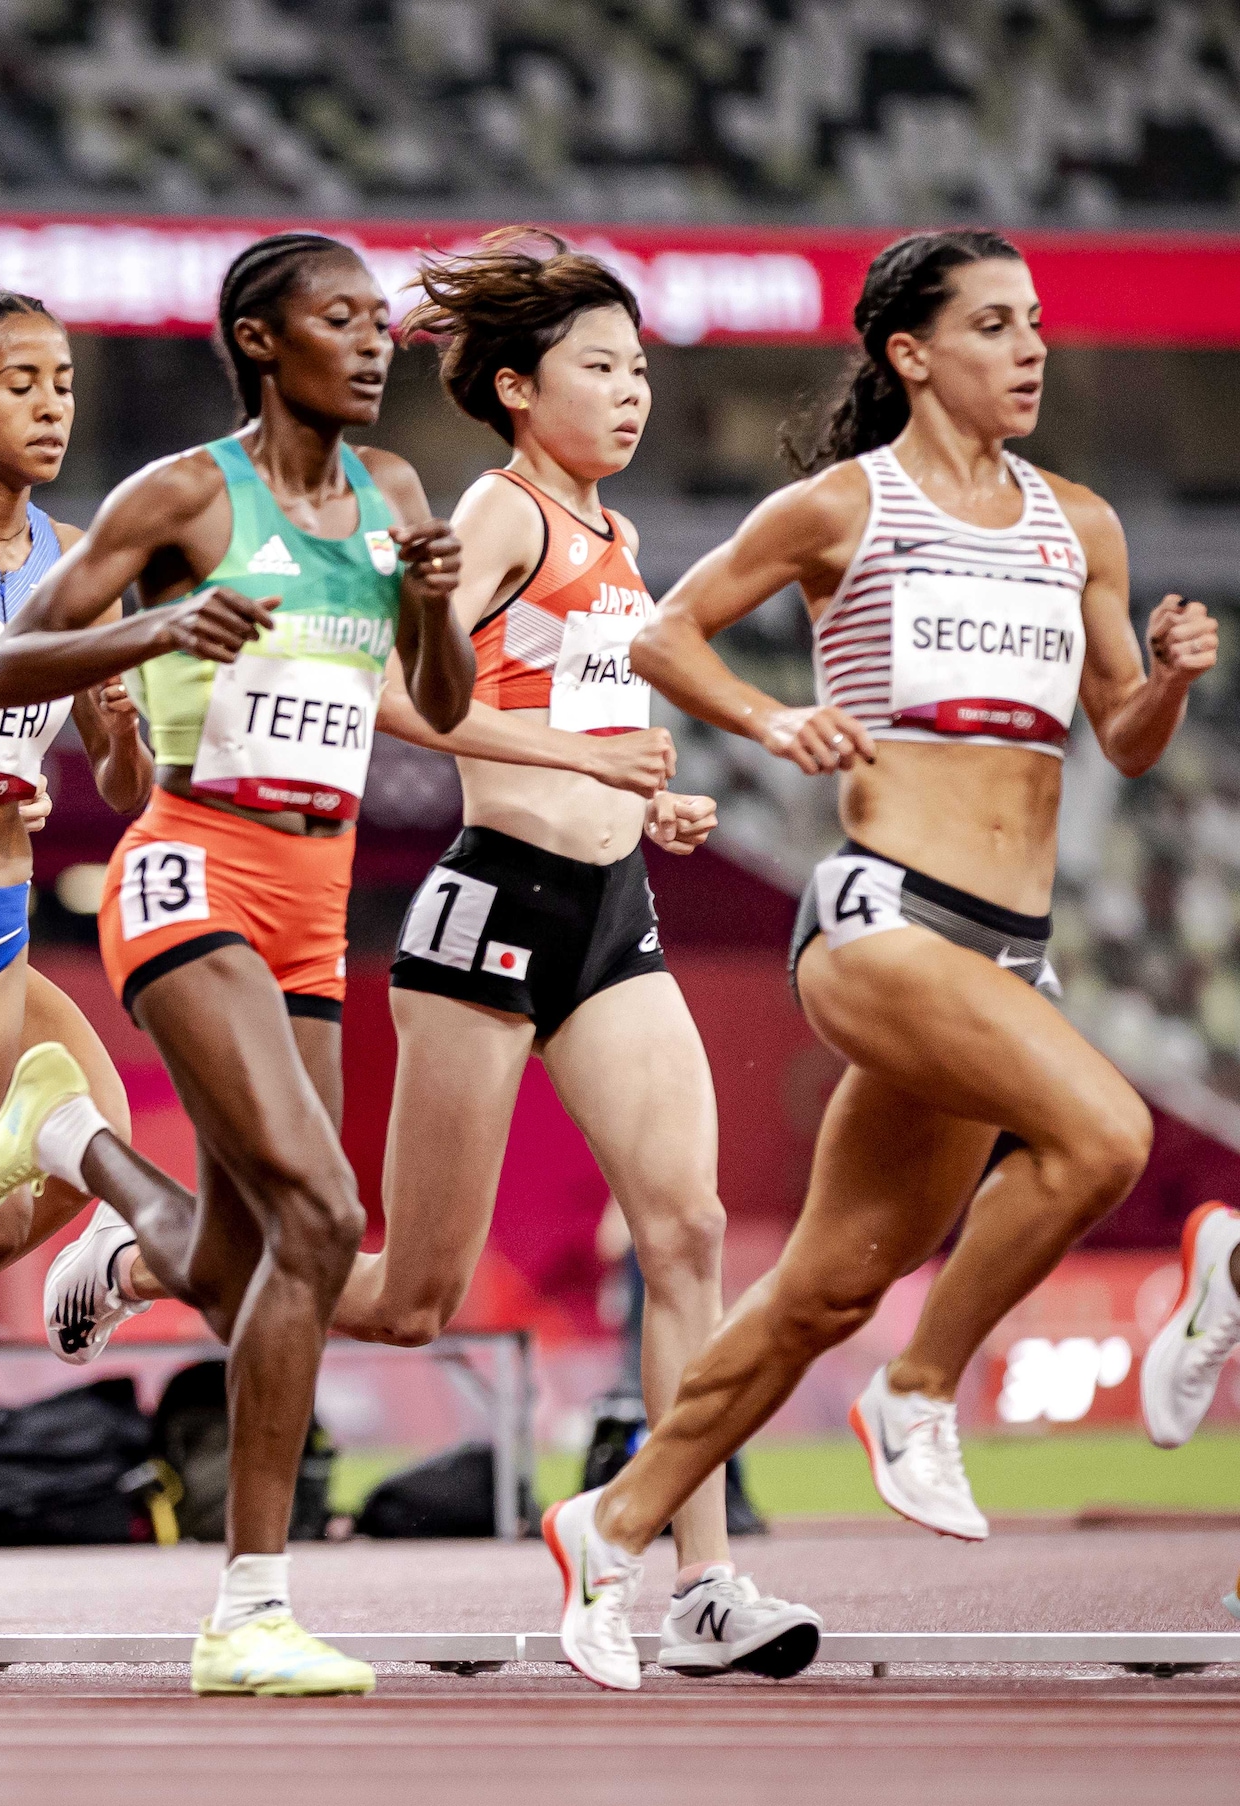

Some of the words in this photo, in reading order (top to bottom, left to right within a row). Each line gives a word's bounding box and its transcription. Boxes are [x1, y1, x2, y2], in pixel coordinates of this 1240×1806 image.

[590, 581, 657, 619] JAPAN
[912, 616, 1074, 664] SECCAFIEN
[245, 691, 367, 750] TEFERI
[134, 853, 191, 922] 13
[836, 868, 881, 924] 4
[436, 882, 463, 953] 1
